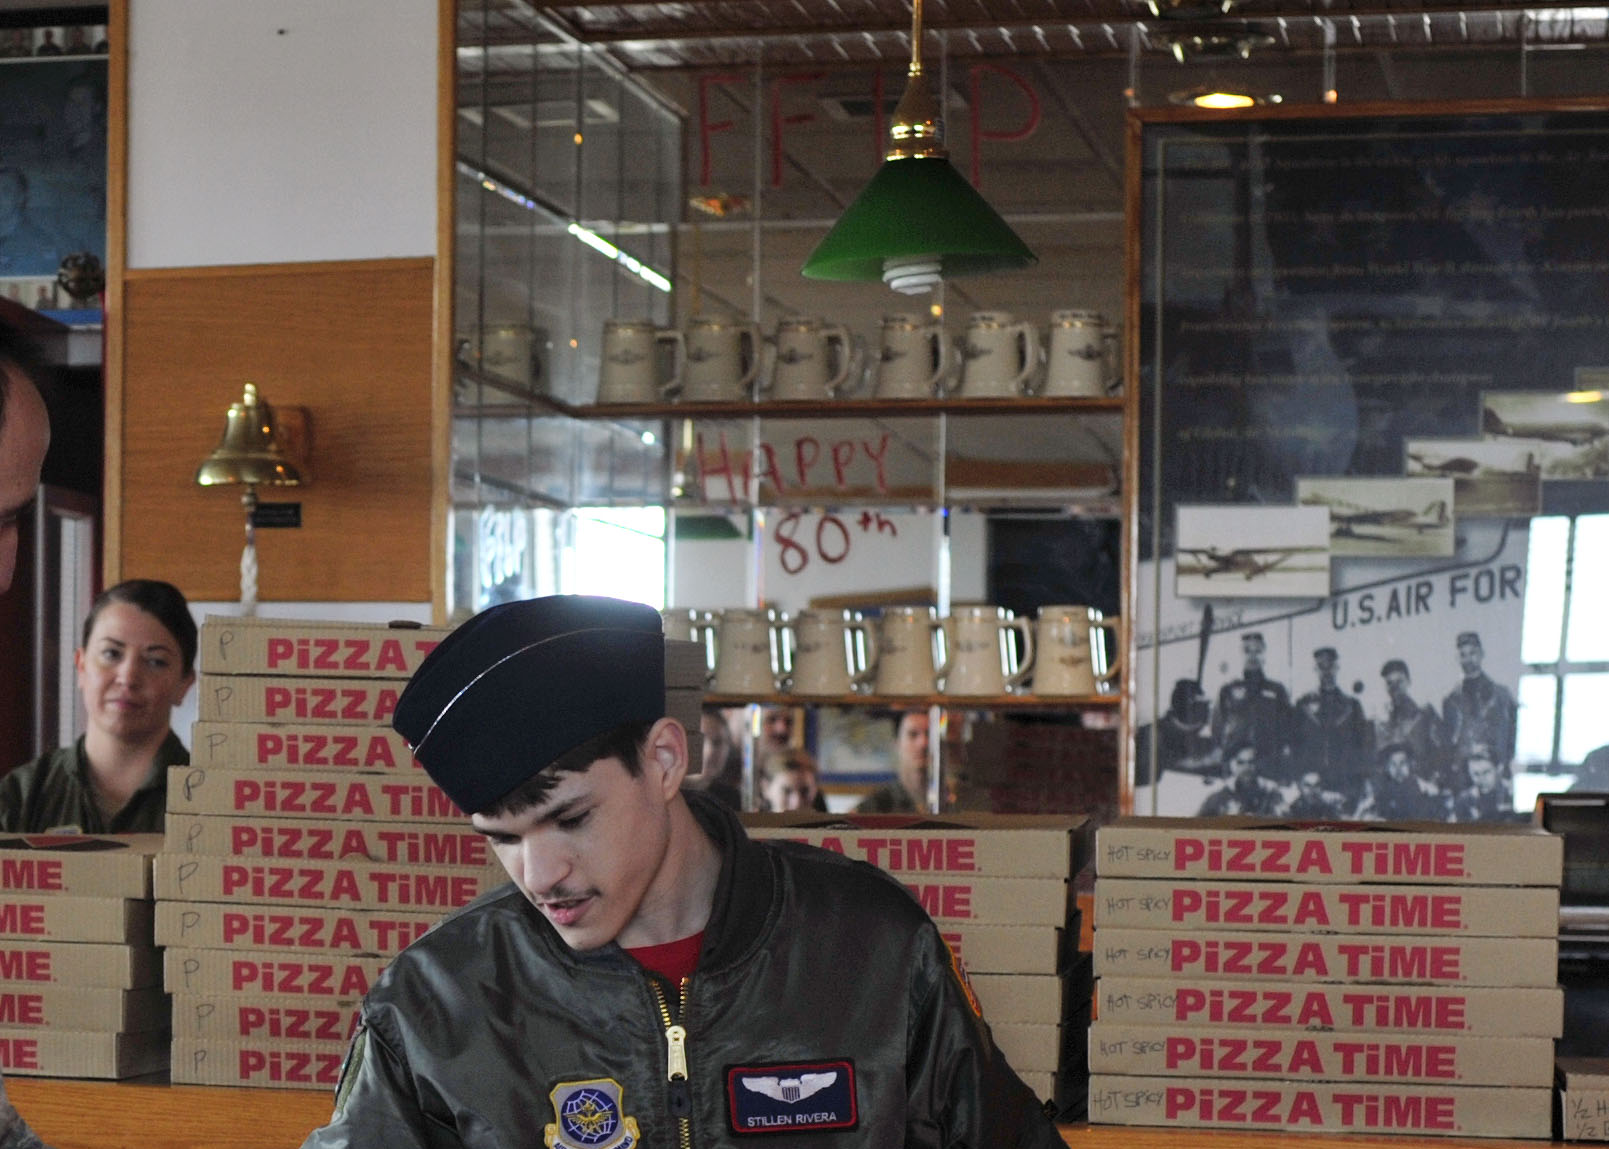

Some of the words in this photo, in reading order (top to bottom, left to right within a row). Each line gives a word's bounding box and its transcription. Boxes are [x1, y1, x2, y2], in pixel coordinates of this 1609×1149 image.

[696, 432, 889, 505] HAPPY
[381, 783, 468, 818] TiM
[239, 1049, 340, 1085] PiZZ
[747, 1114, 792, 1128] STILLEN
[795, 1111, 837, 1124] RIVERA
